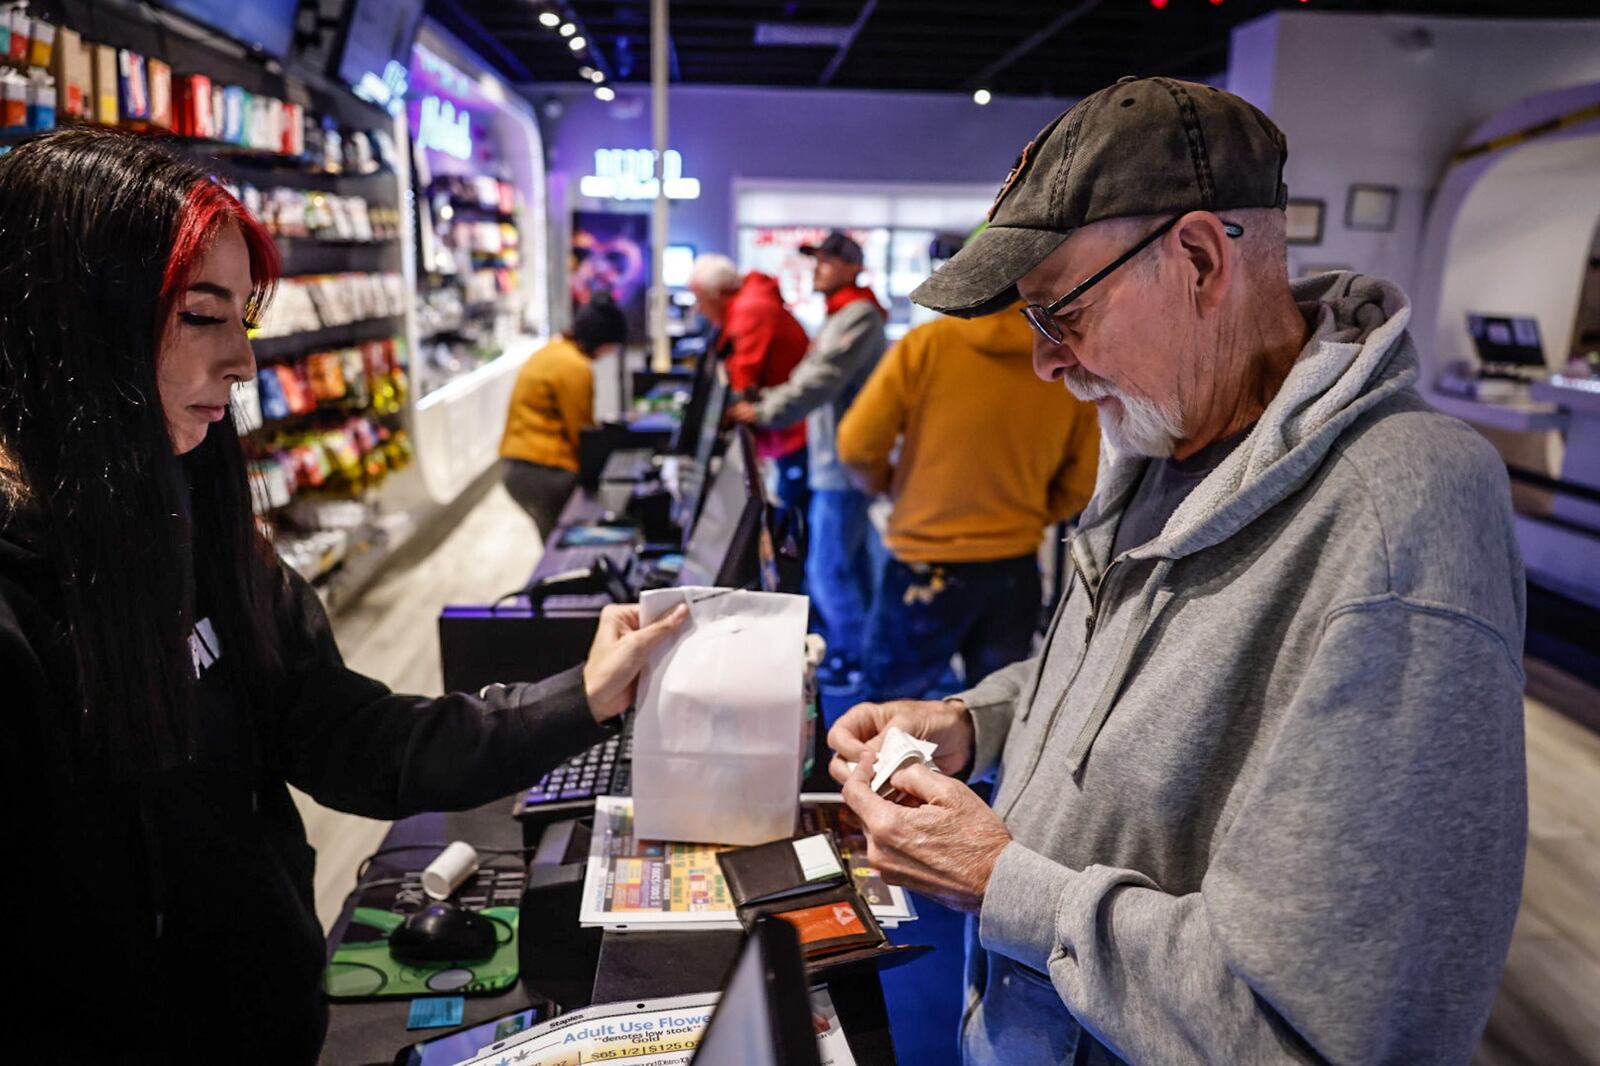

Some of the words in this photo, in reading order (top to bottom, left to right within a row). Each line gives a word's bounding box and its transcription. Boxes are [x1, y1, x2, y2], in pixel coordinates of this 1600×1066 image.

[562, 1024, 614, 1044] Adult
[621, 1021, 654, 1033] Use
[659, 1013, 713, 1029] Flowe
[645, 1030, 664, 1039] low
[632, 1034, 660, 1044] Gold
[621, 1047, 640, 1056] 1/2
[649, 1041, 682, 1053] $125
